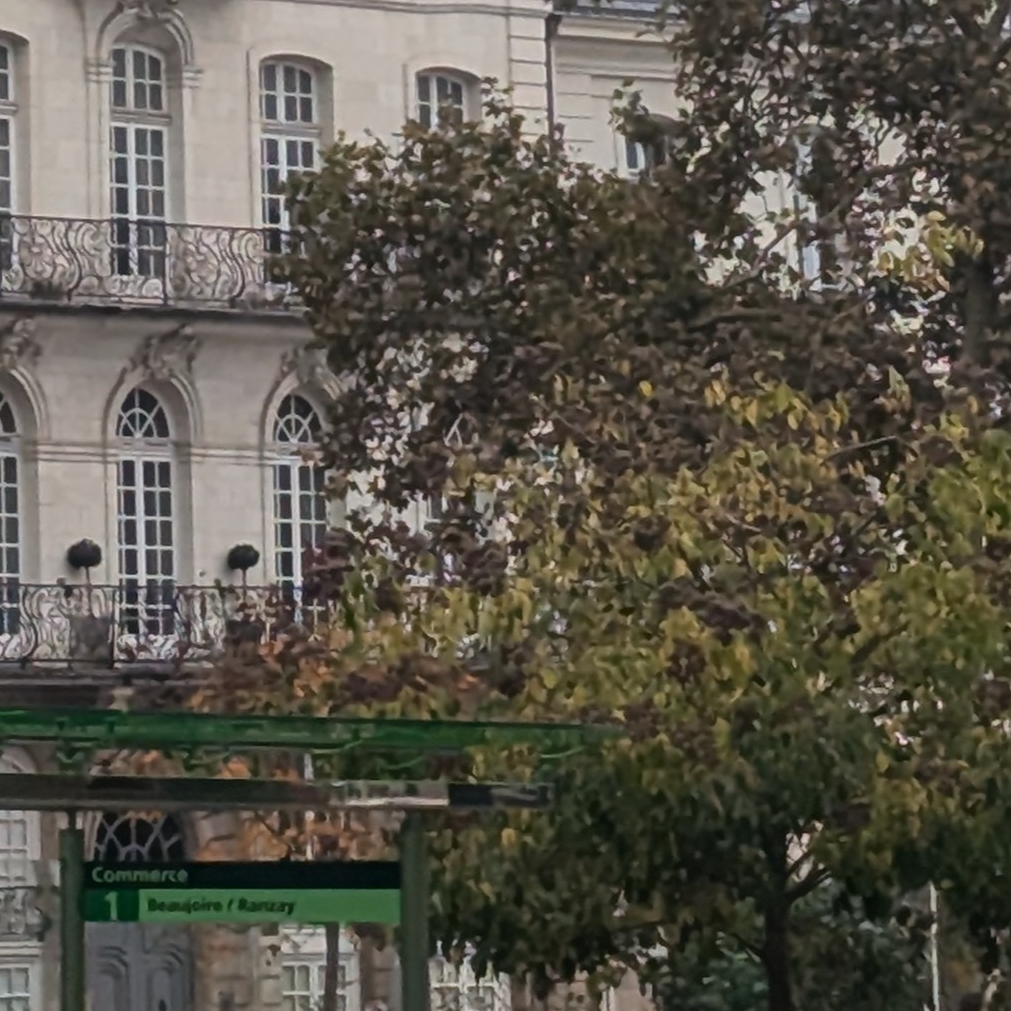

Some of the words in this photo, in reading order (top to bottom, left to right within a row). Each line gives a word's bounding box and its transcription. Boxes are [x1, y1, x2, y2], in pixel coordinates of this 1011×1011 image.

[91, 865, 189, 884] Commerce
[103, 891, 120, 921] 1
[147, 898, 224, 915] Beaujoire
[237, 898, 295, 916] Ranzay
